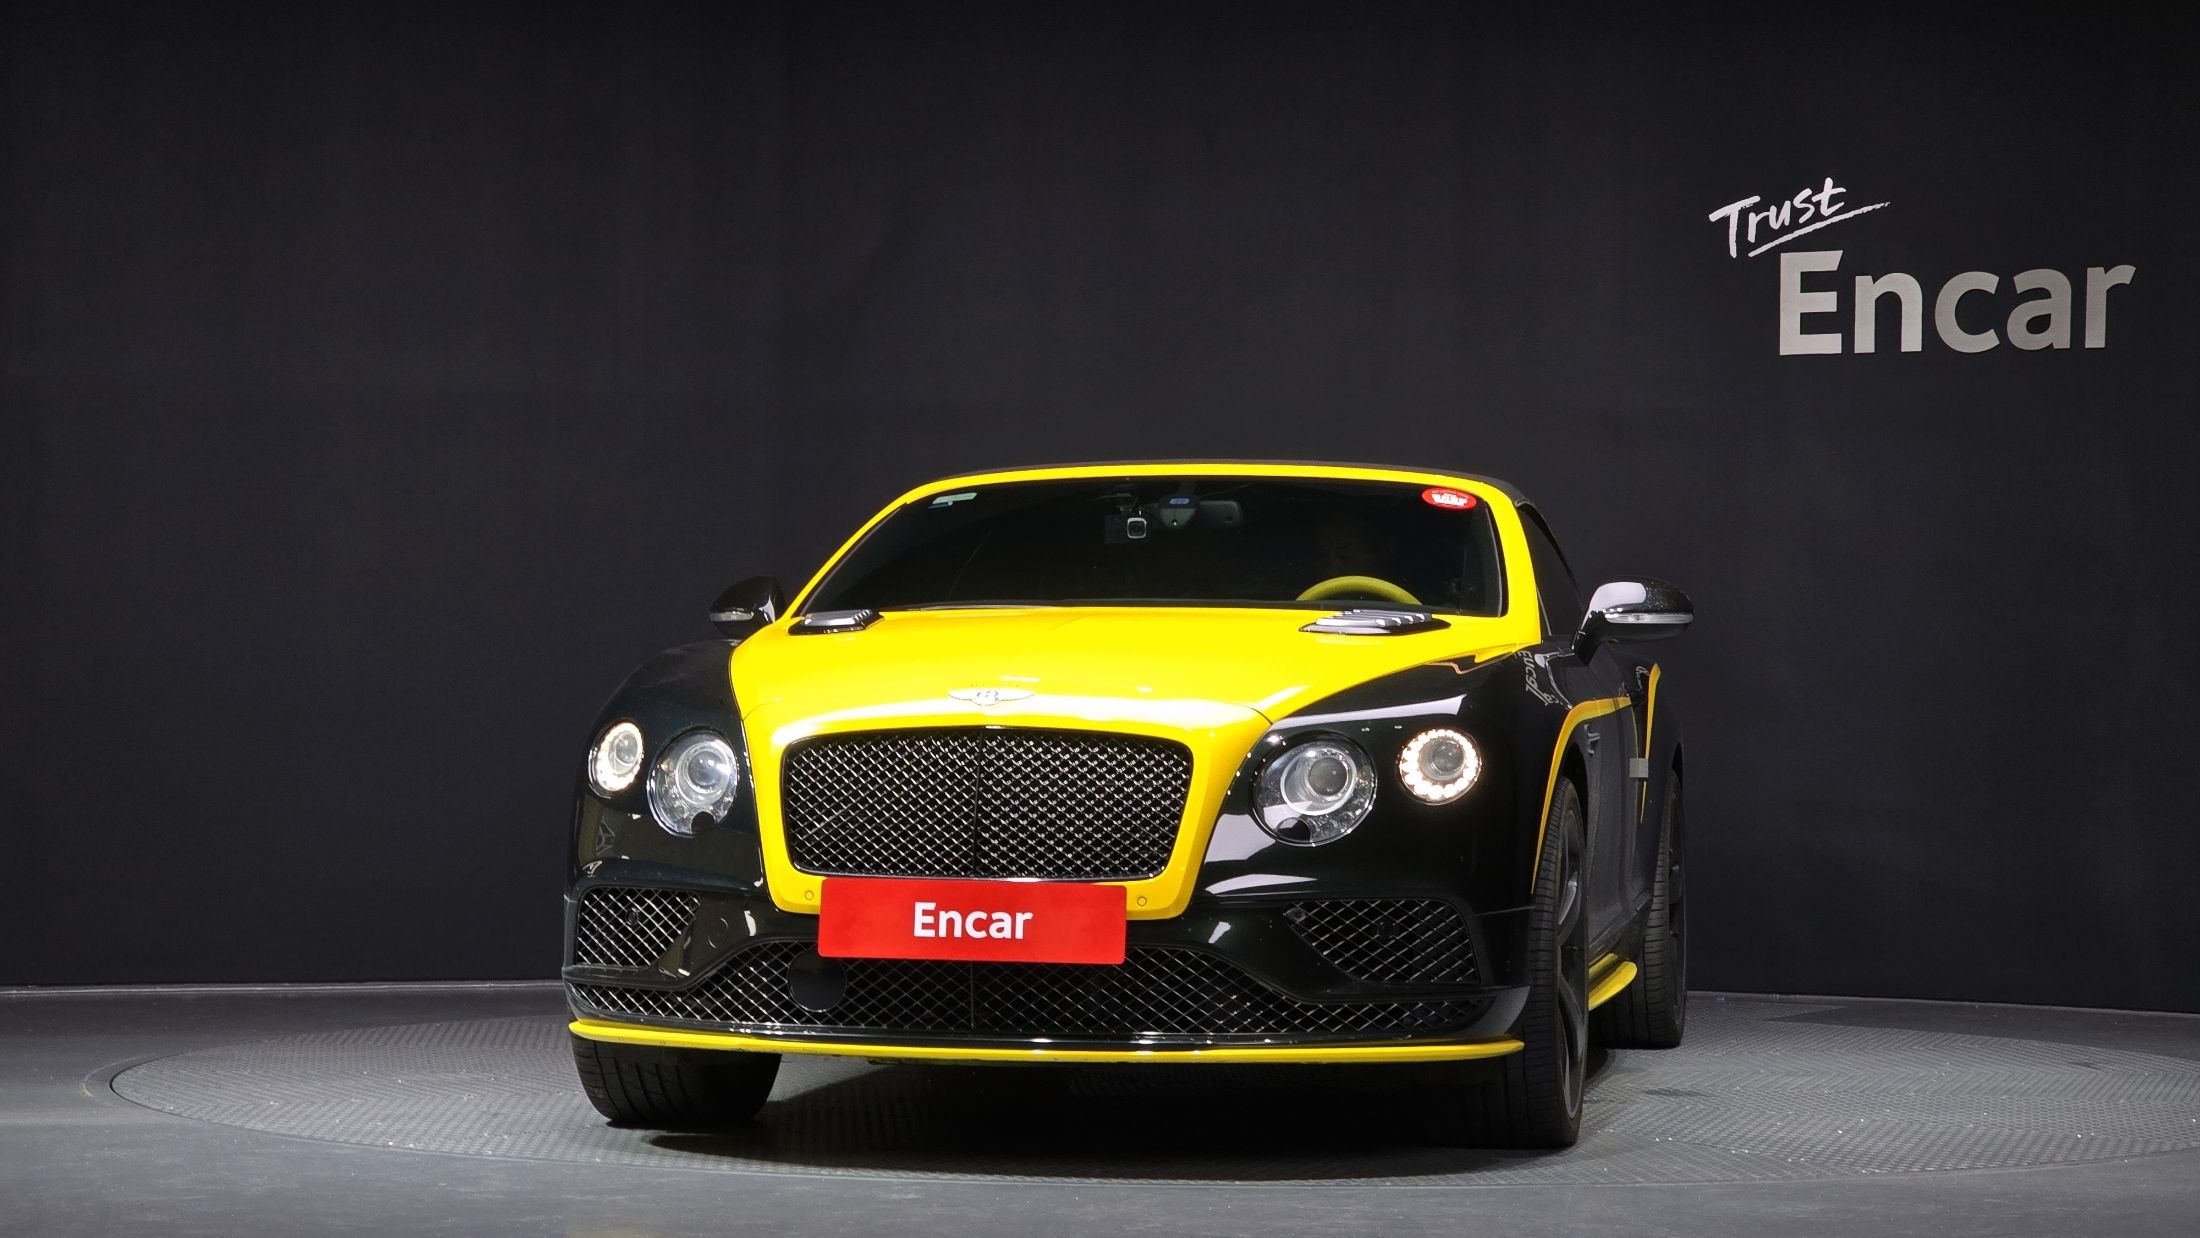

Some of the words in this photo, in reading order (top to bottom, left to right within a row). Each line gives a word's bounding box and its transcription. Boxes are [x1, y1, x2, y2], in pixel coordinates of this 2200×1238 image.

[1708, 177, 1847, 258] Trust
[1779, 249, 2137, 356] Encar
[913, 901, 1034, 940] Encar
